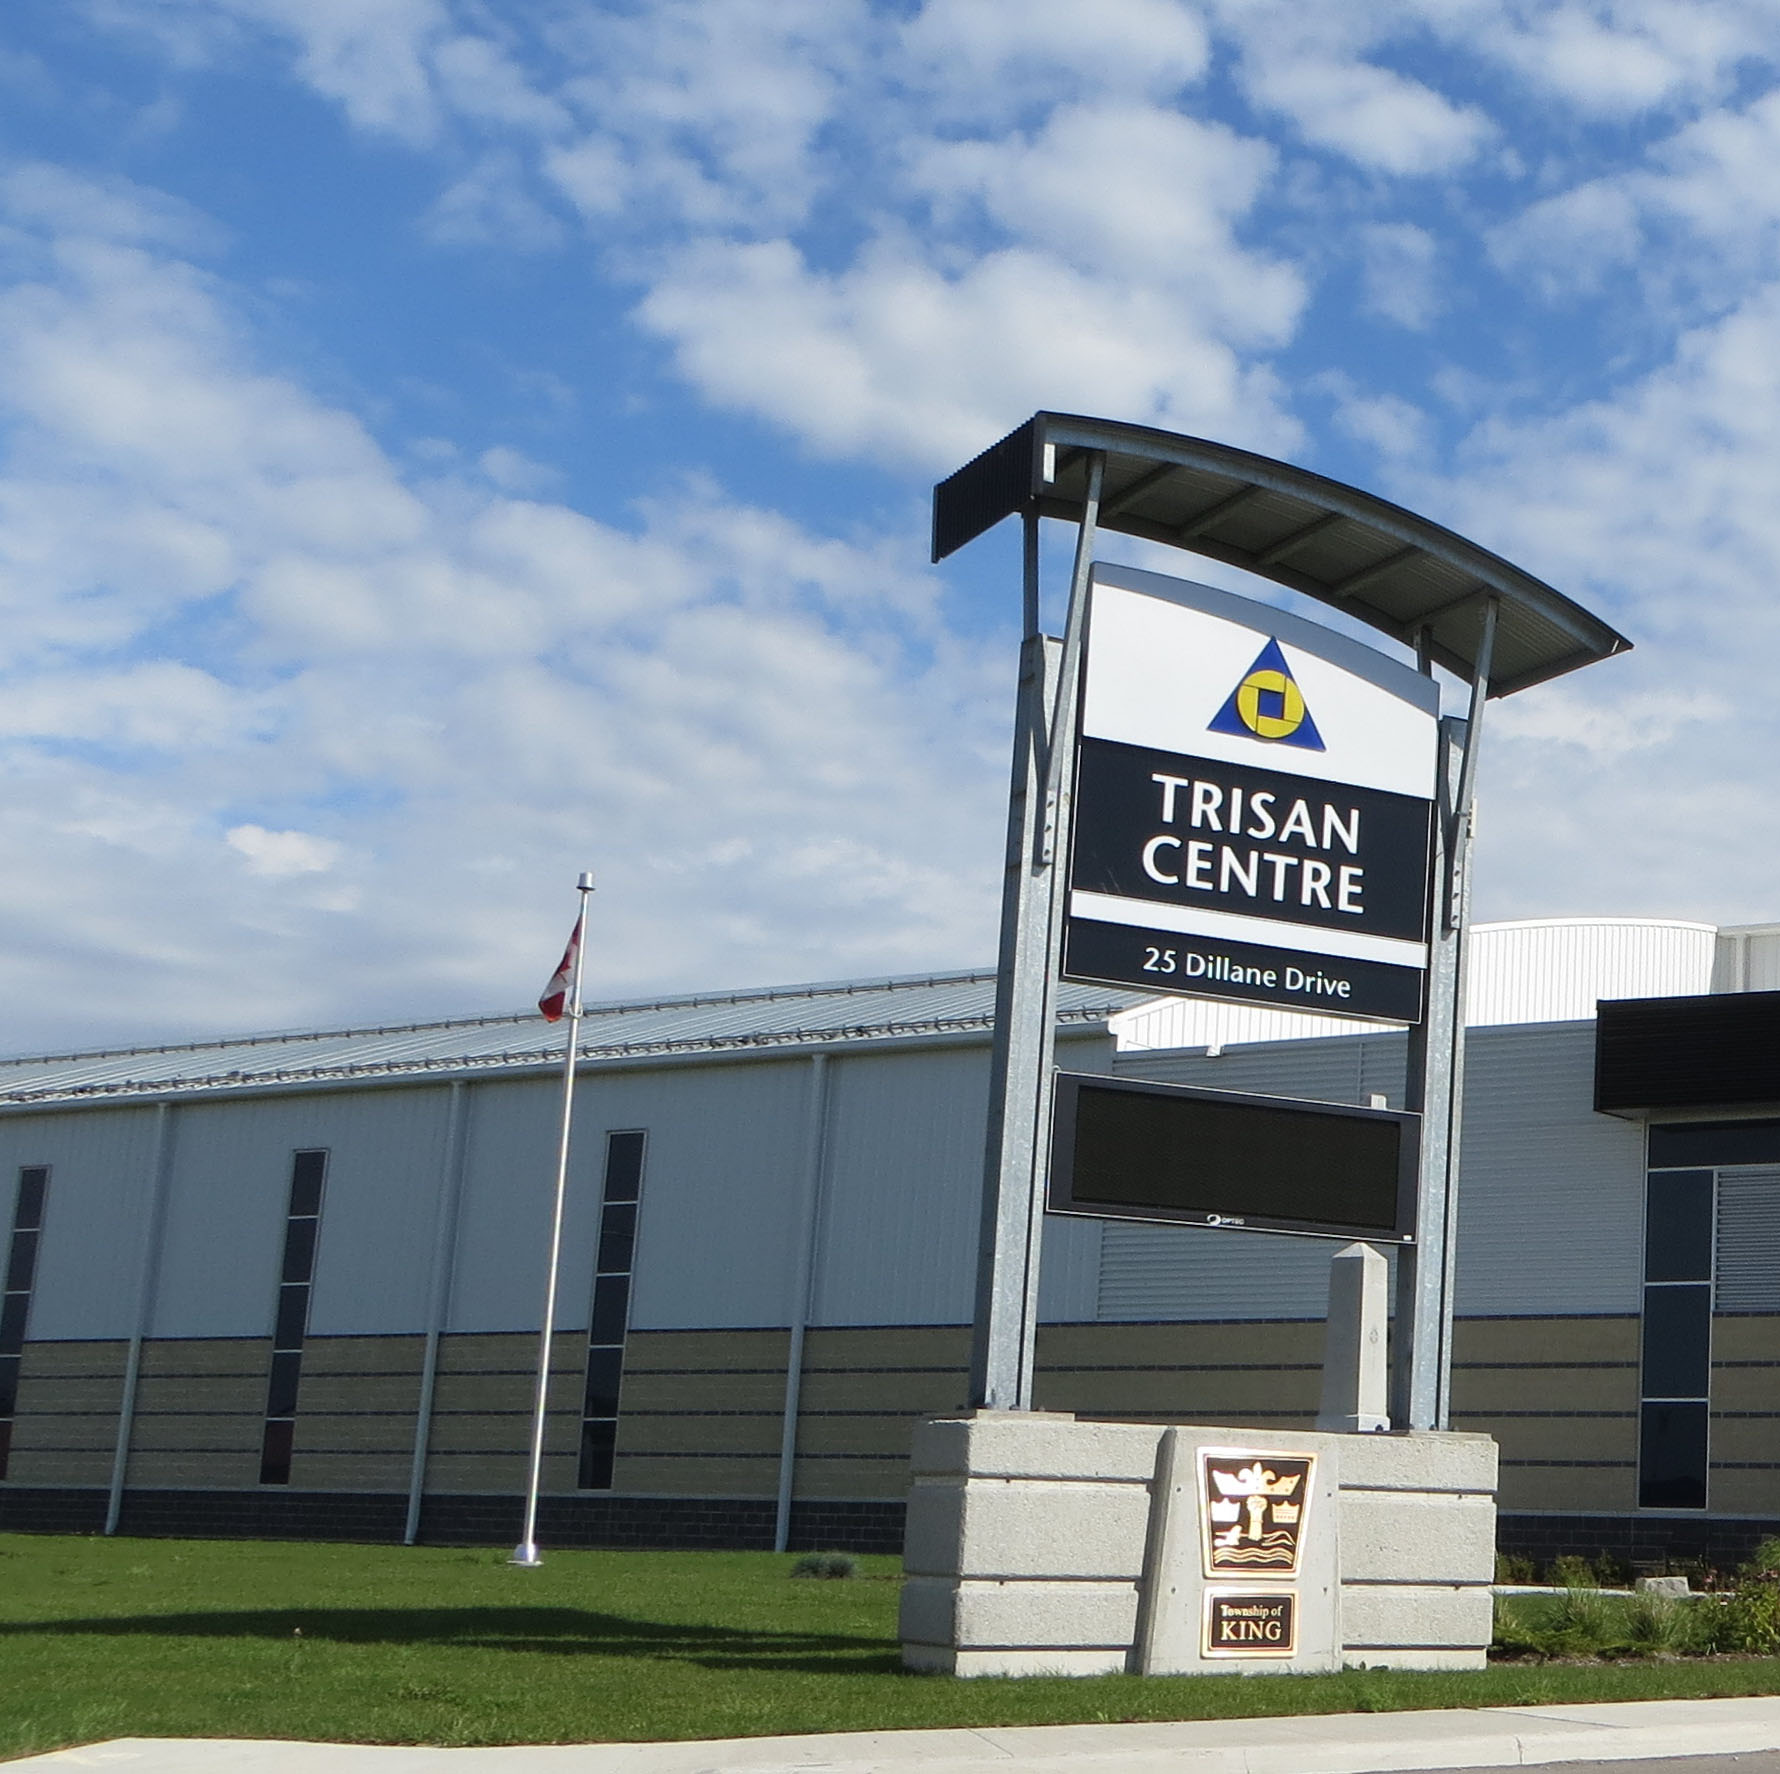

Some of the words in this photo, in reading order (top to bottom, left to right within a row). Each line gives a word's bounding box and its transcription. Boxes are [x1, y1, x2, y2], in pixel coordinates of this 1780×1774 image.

[1151, 773, 1360, 854] TRISAN
[1142, 836, 1365, 914] CENTRE
[1143, 947, 1177, 973] 25
[1186, 953, 1277, 988] Dillane
[1285, 968, 1352, 999] Drive
[1220, 1604, 1269, 1618] Township
[1271, 1605, 1284, 1617] of
[1220, 1621, 1282, 1641] KING
